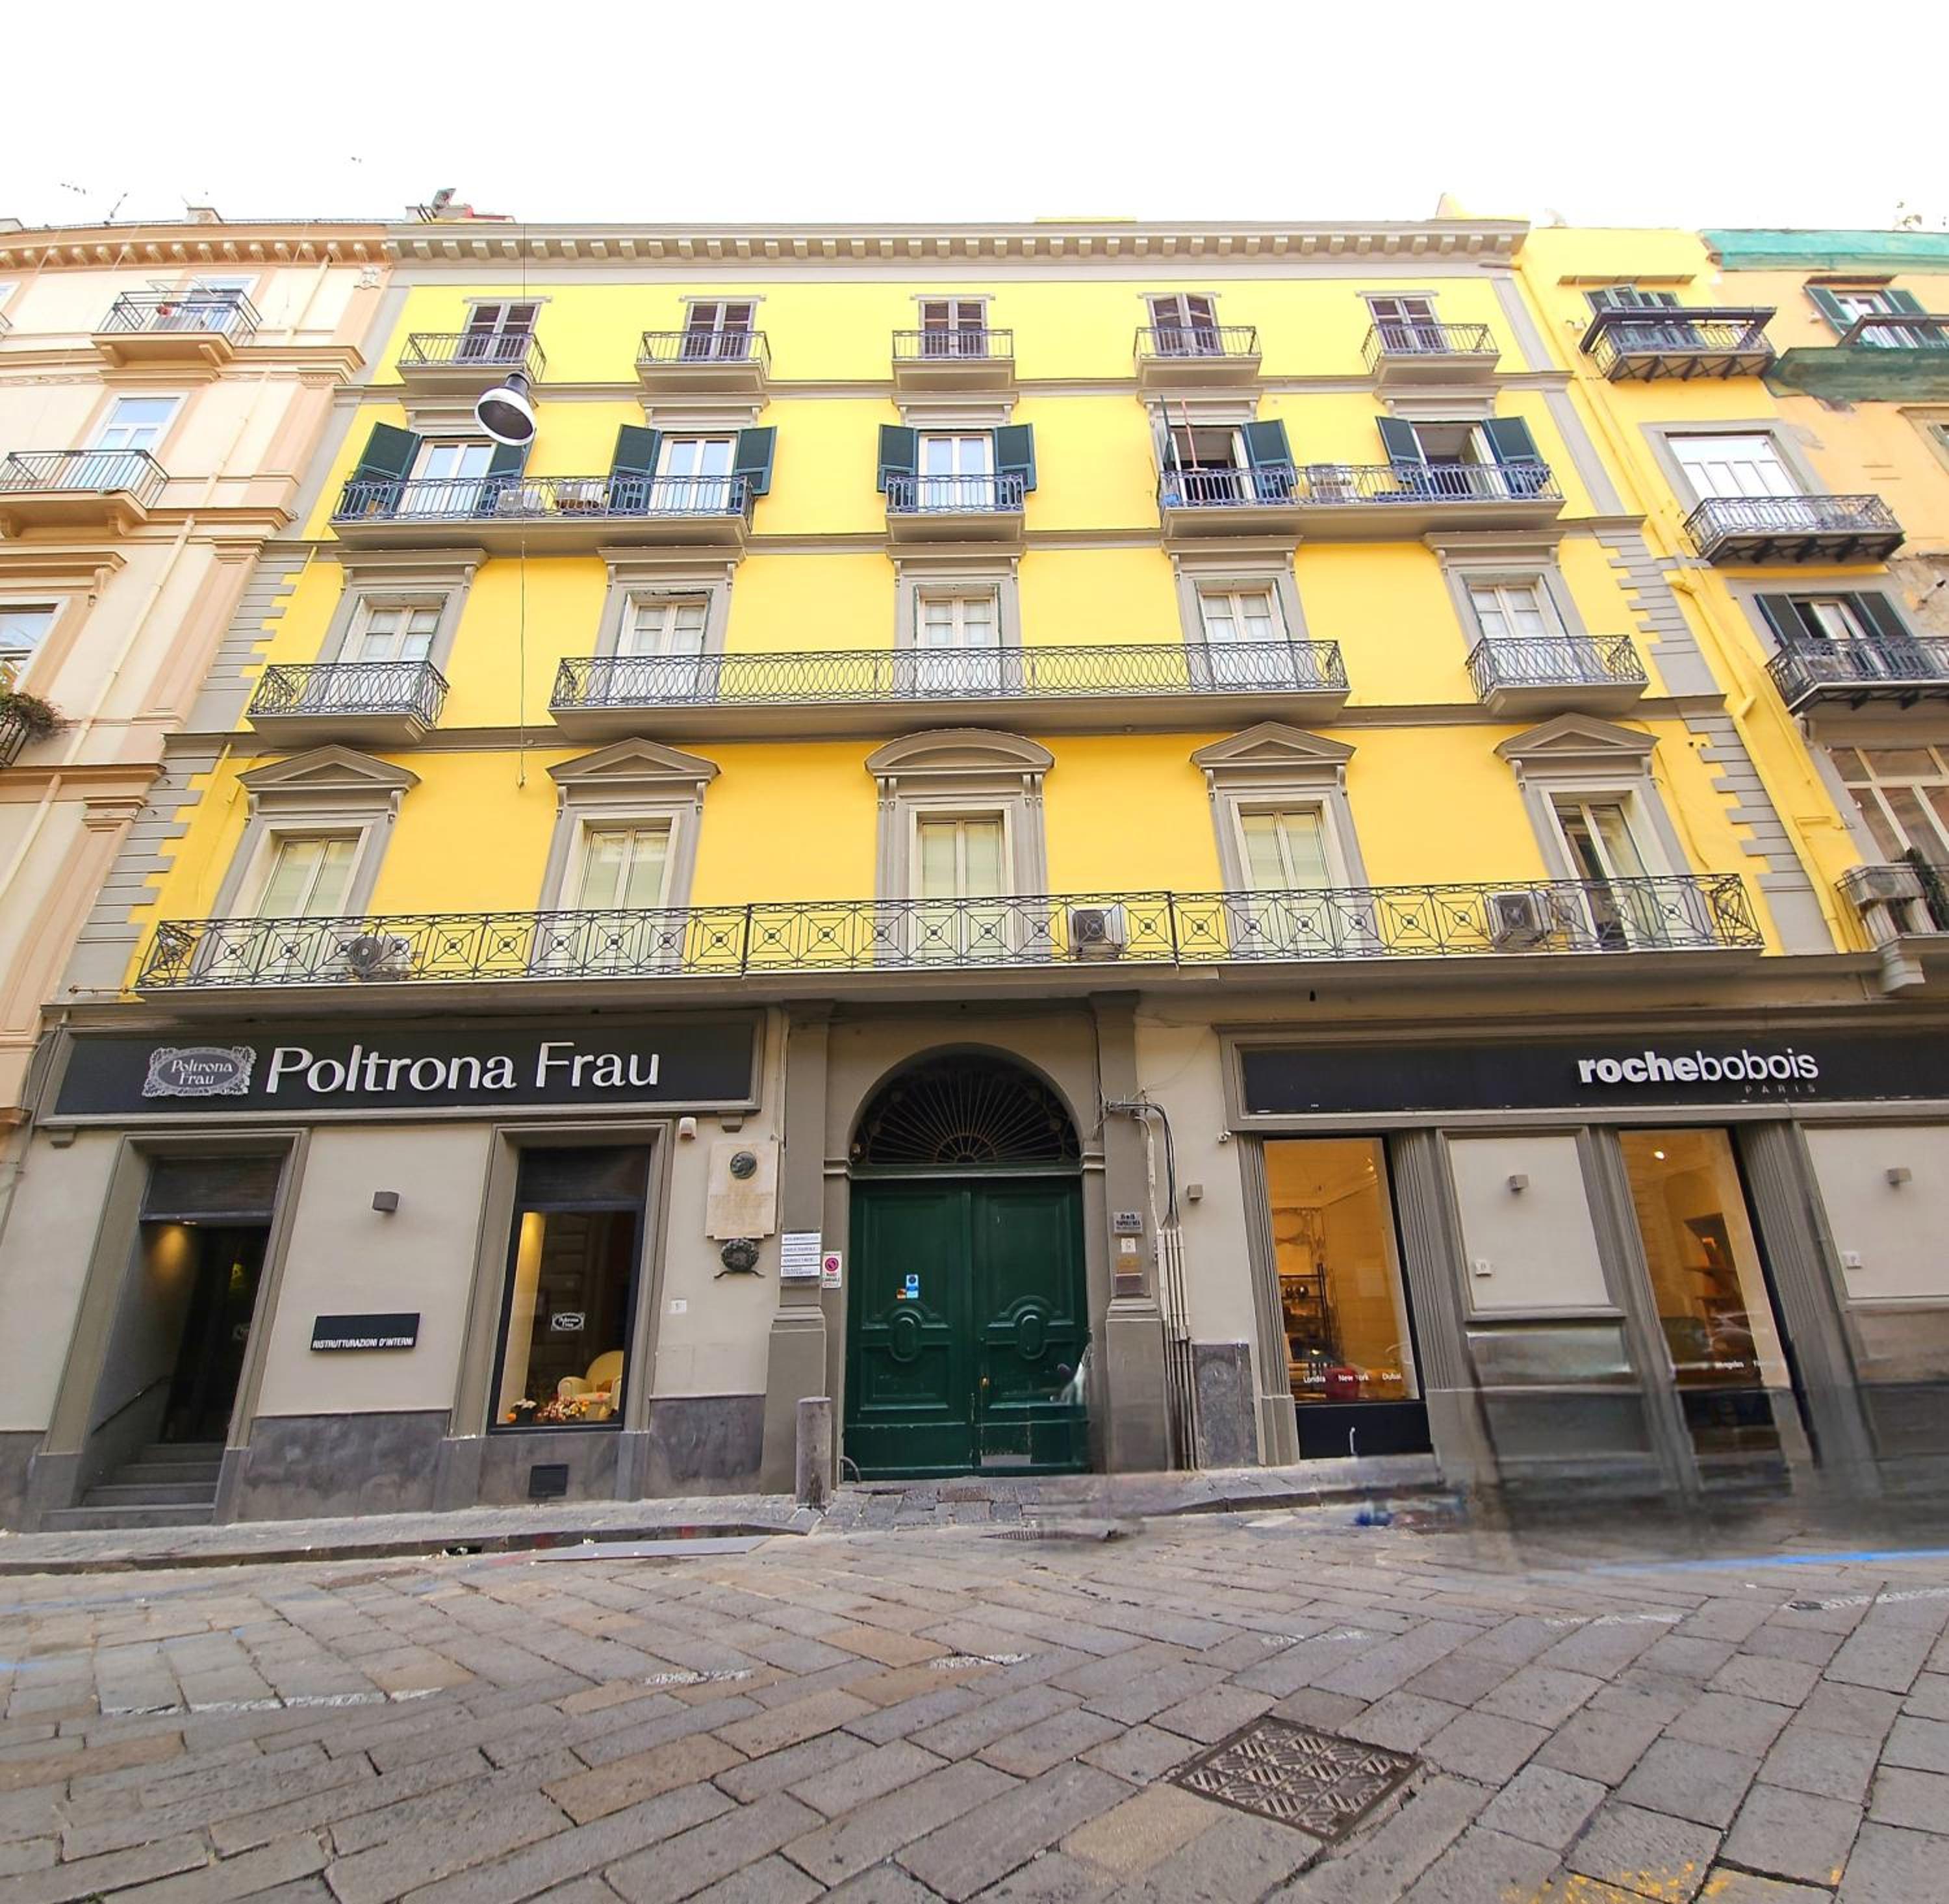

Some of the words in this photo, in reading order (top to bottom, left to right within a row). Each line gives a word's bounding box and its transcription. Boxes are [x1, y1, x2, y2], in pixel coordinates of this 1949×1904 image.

[171, 1059, 233, 1072] Poltrona
[266, 1045, 517, 1093] Poltrona
[536, 1042, 659, 1087] Frau
[1578, 1048, 1818, 1083] rochebobois
[179, 1072, 214, 1085] Frau
[1744, 1085, 1816, 1094] PARIS
